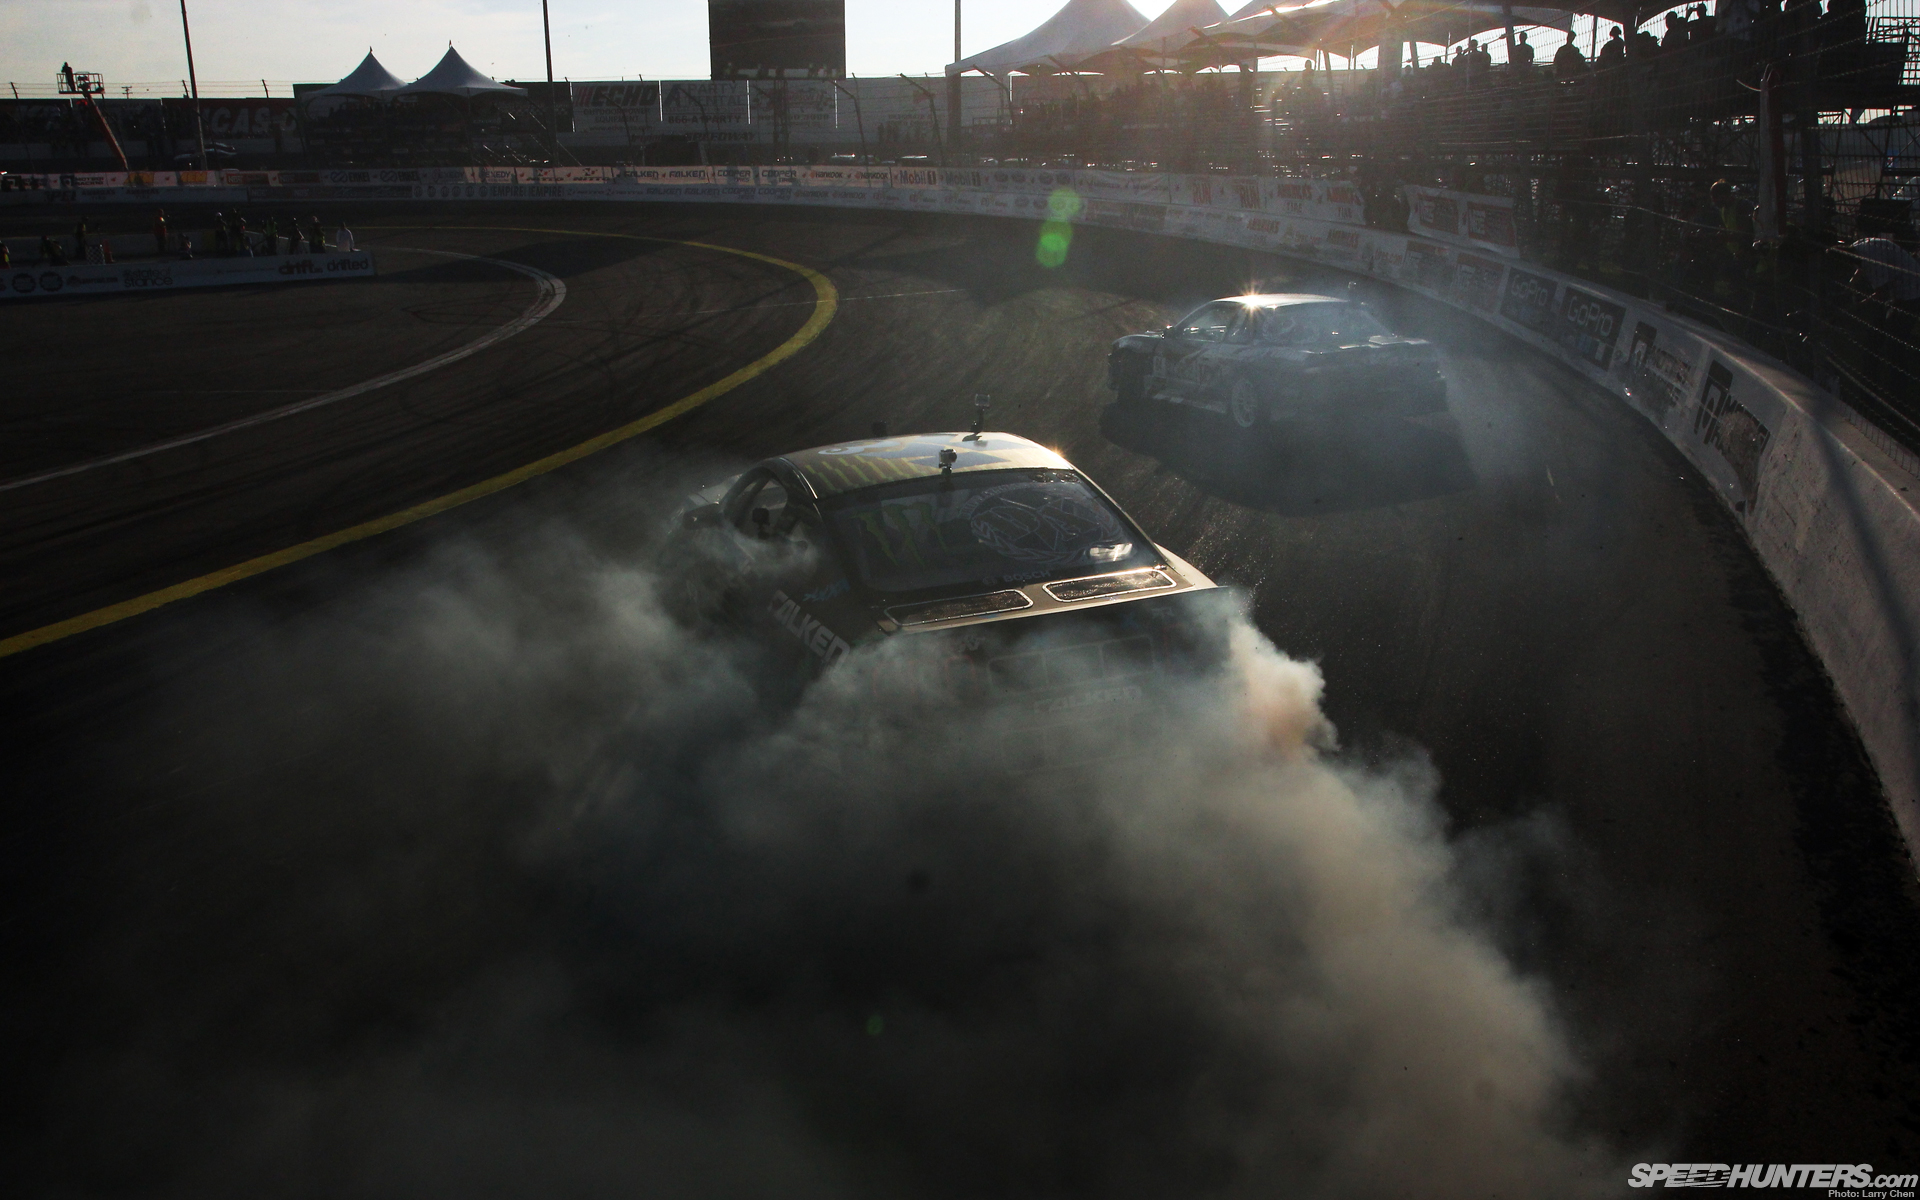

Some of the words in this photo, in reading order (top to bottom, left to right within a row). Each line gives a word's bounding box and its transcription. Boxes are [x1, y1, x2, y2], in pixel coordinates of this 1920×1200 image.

[688, 83, 736, 94] PARTY
[591, 85, 658, 107] ECHO
[624, 170, 659, 179] FALKEN
[669, 170, 705, 178] FALKEN
[717, 169, 751, 177] COOPER
[761, 169, 797, 178] COOPER
[899, 169, 926, 184] Mobil
[646, 187, 682, 196] FALKEN
[684, 187, 720, 196] FALKEN
[721, 187, 756, 195] COOPER
[758, 187, 792, 195] COOPER
[124, 276, 174, 288] stance
[1511, 274, 1548, 306] GoPro
[1567, 295, 1614, 337] GoPro
[1003, 570, 1051, 583] BOSCH
[766, 589, 851, 668] FALKEN
